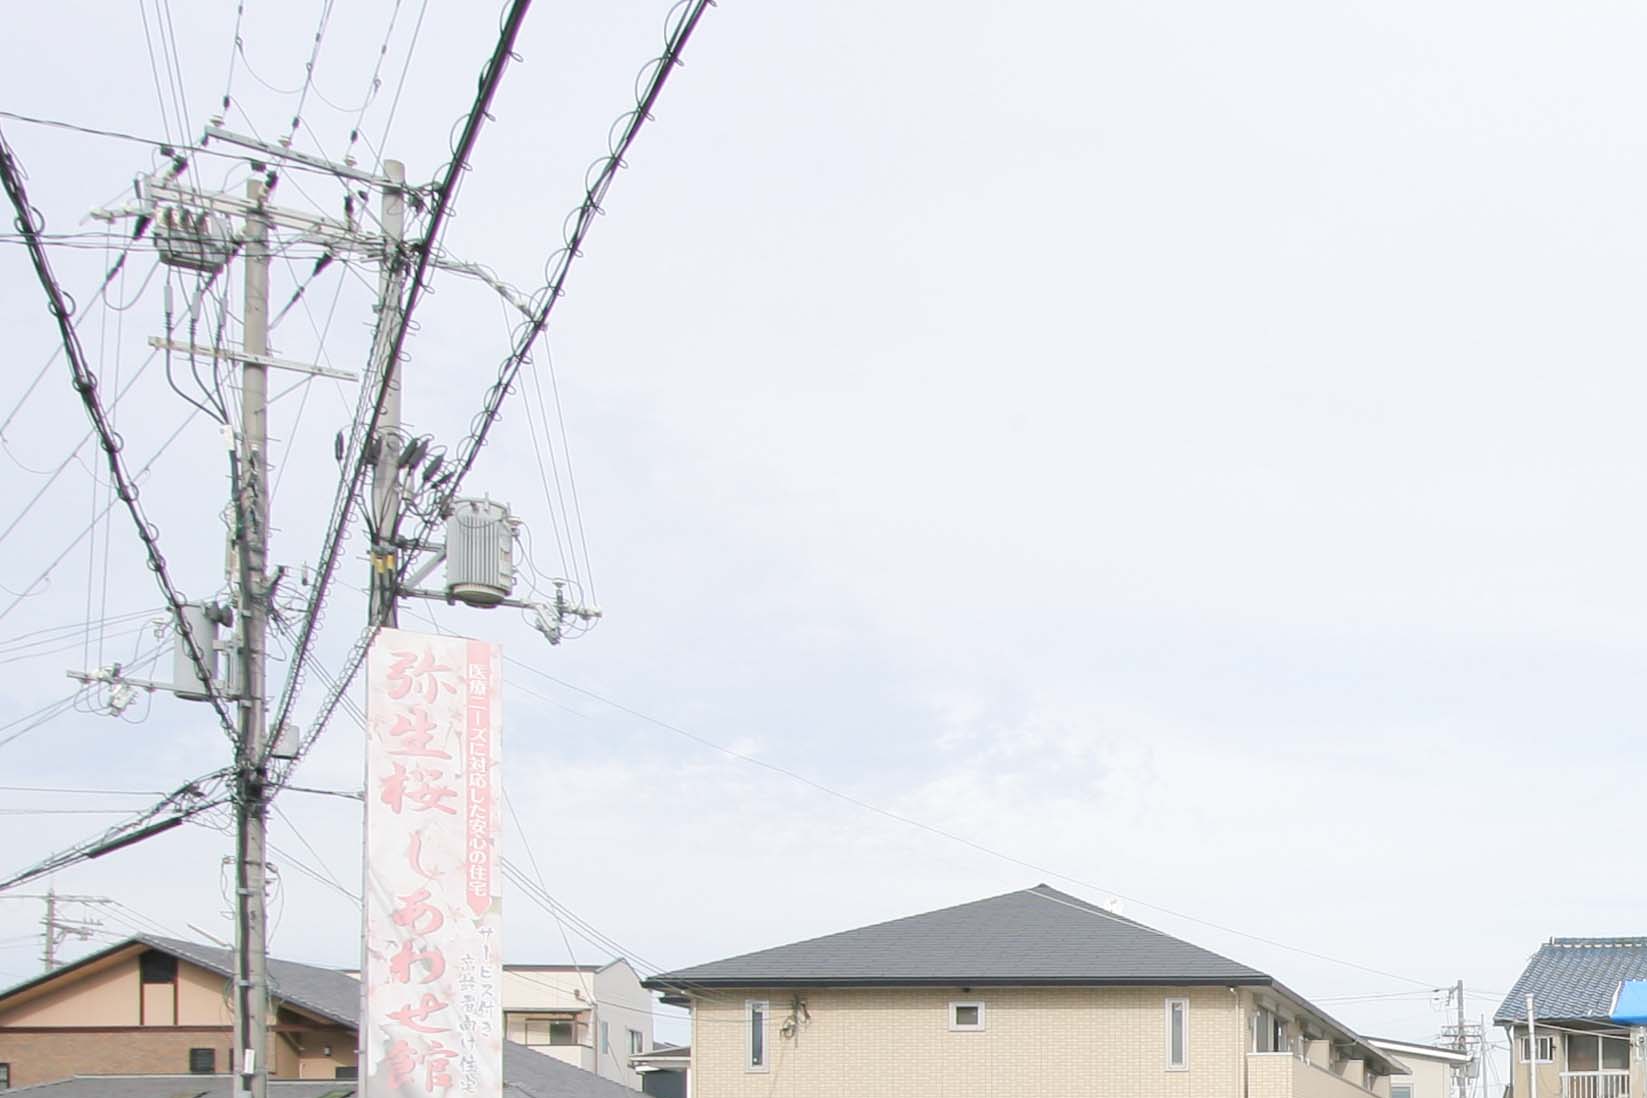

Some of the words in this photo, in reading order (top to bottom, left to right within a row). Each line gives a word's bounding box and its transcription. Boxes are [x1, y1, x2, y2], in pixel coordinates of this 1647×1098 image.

[379, 646, 459, 1093] 弥生桜しあわせ館
[468, 663, 490, 896] 医療ニーズに対応した安心の住宅
[476, 927, 496, 1037] サービス付き
